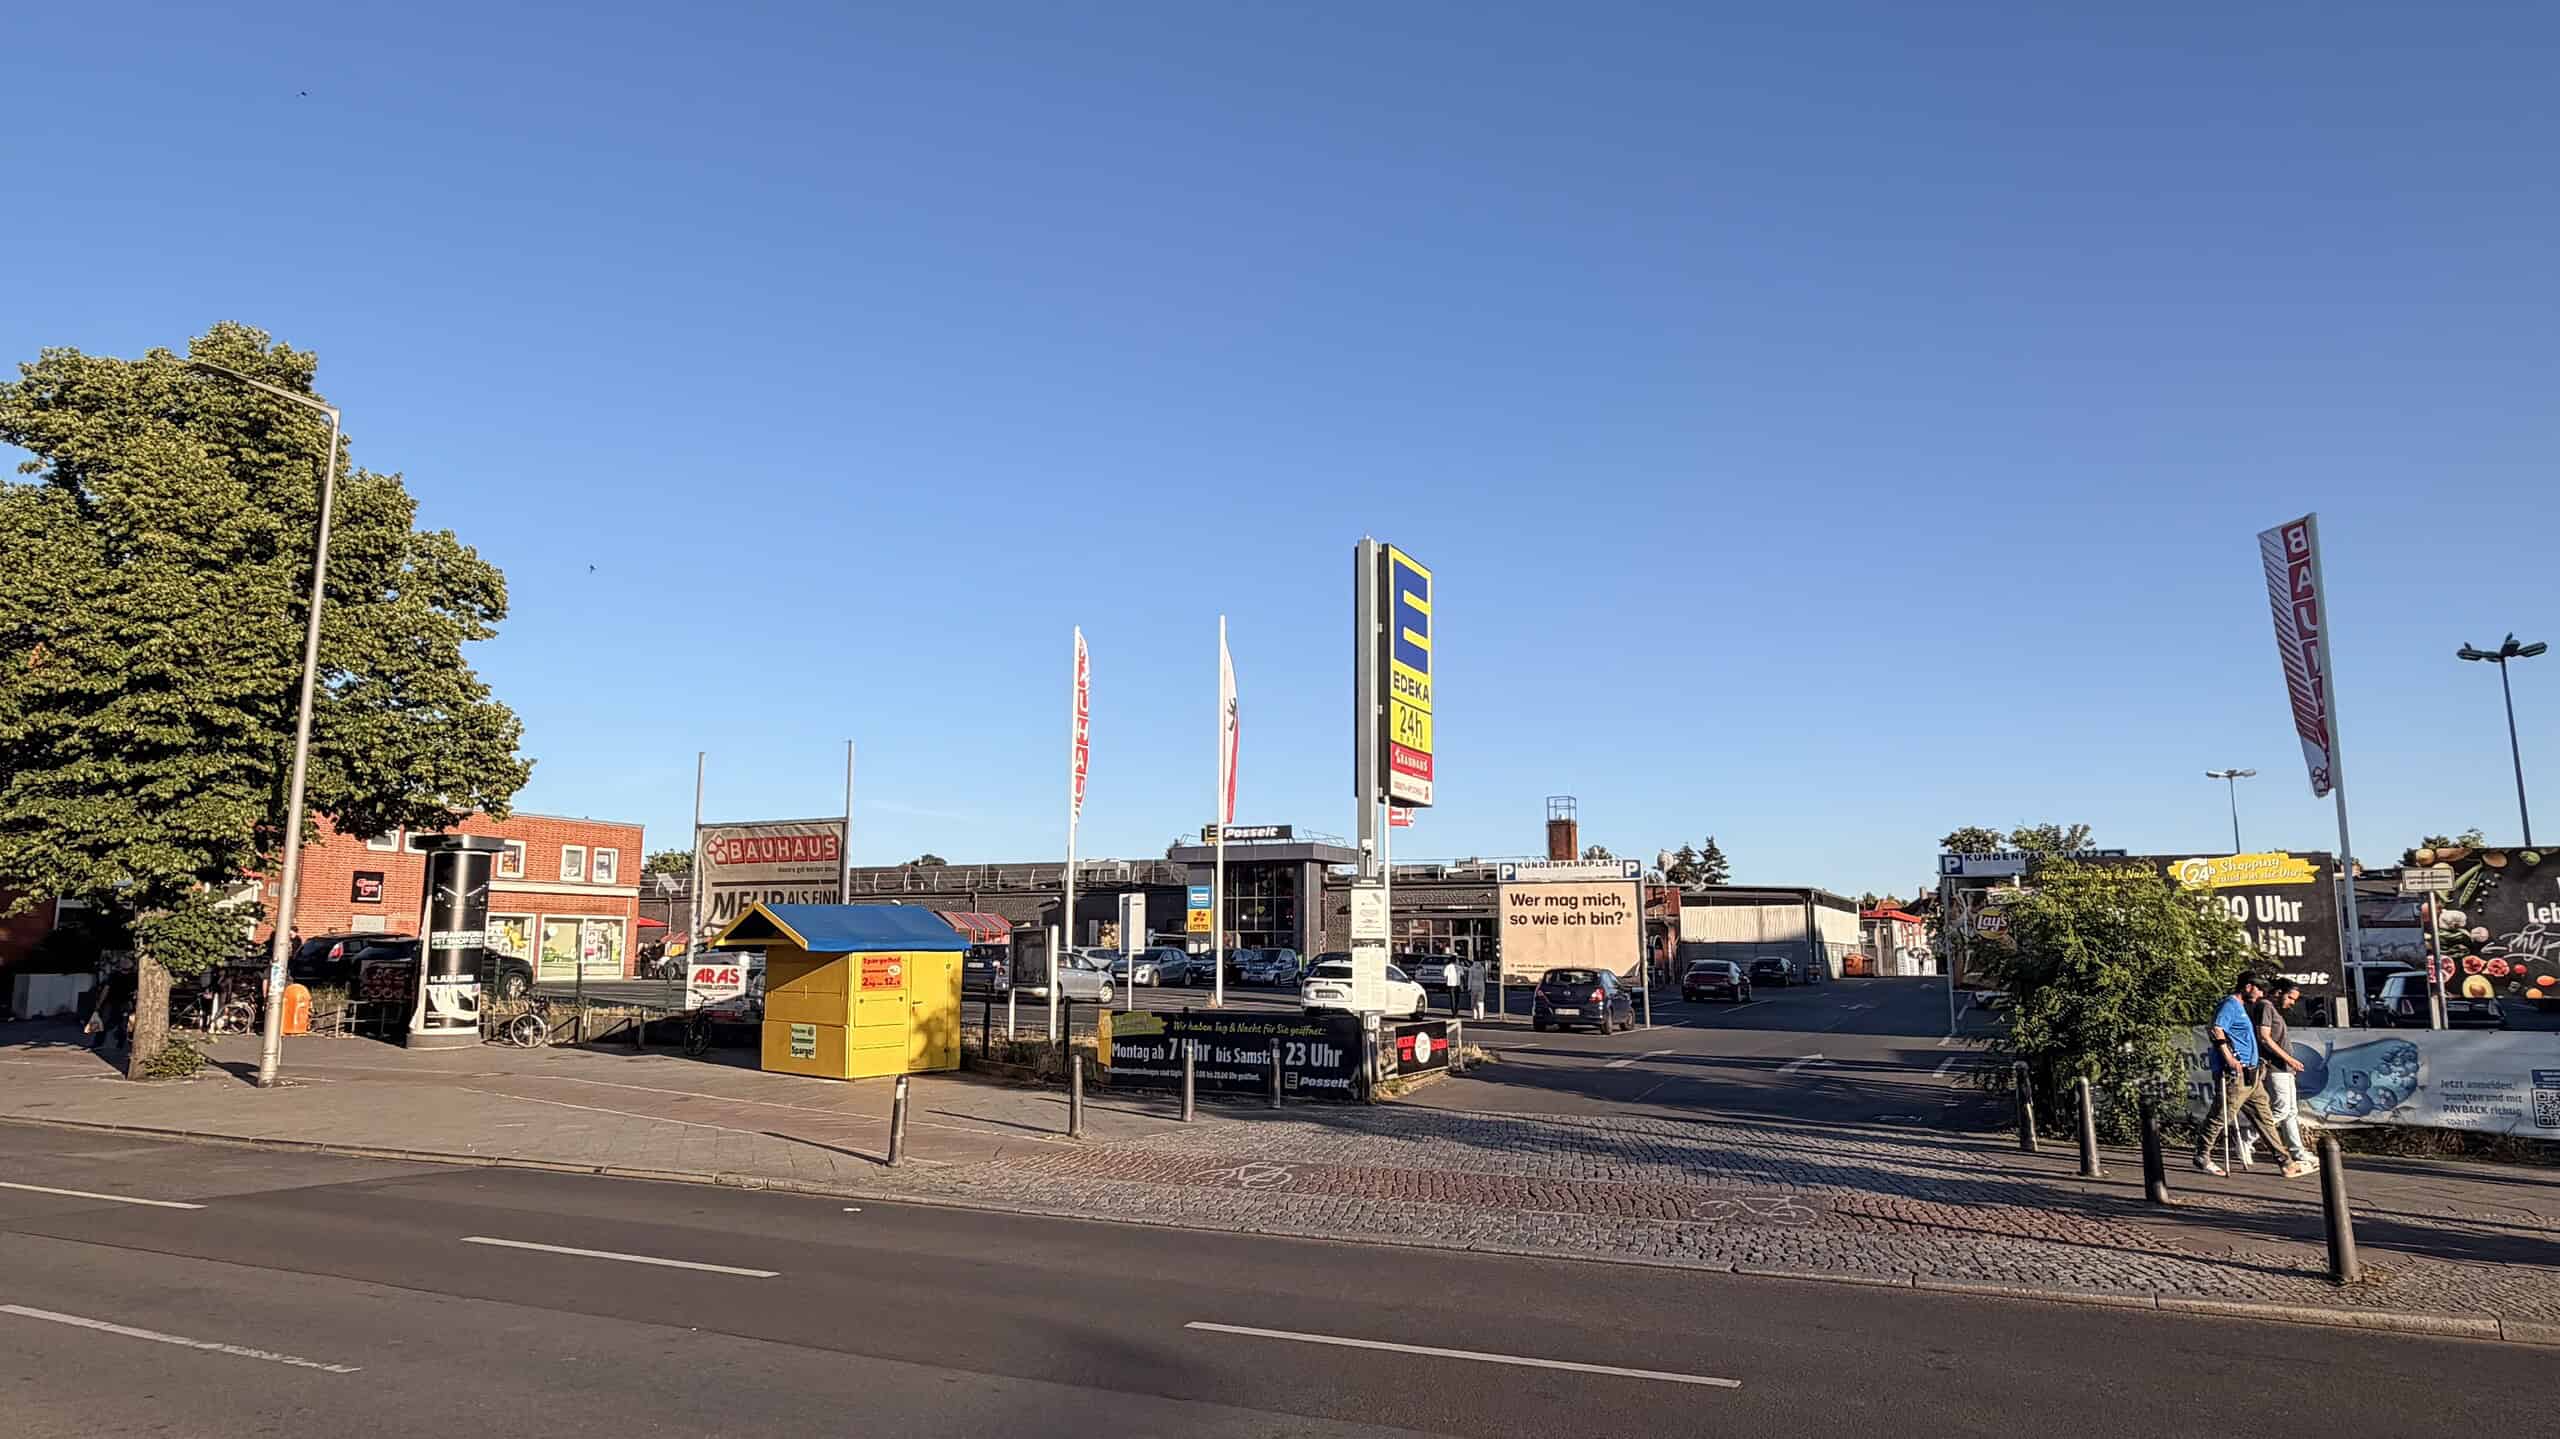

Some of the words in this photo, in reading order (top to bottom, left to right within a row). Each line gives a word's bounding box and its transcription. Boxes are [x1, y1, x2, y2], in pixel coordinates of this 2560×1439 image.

[1393, 670, 1430, 703] EDEKA
[1400, 706, 1423, 739] 24h
[729, 836, 838, 860] BAUHAUS
[1965, 850, 2097, 862] KUNDENPARPLATZ
[1518, 859, 1621, 870] KUNDENPARKPLATZ
[2220, 858, 2281, 873] Shopping
[709, 891, 785, 919] MER
[1510, 893, 1540, 907] Wer
[1545, 895, 1577, 910] mag
[1583, 893, 1626, 909] mich,
[2256, 895, 2303, 922] Uhr
[1510, 914, 1527, 925] so
[1532, 912, 1558, 925] wie
[1563, 912, 1586, 925] ich
[1977, 913, 2008, 931] Lay's
[2257, 928, 2306, 957] Uhr
[693, 967, 740, 984] ARAS
[2276, 971, 2330, 985] selt
[1187, 1021, 1212, 1031] haben
[1215, 1022, 1228, 1034] Tag
[1237, 1022, 1261, 1033] Nacht
[1277, 1024, 1289, 1034] Sie
[1112, 1042, 1149, 1062] Montag
[1152, 1044, 1164, 1060] ab
[1169, 1038, 1178, 1060] 7
[1215, 1046, 1231, 1063] bis
[1233, 1047, 1271, 1064] Samst
[1285, 1042, 1306, 1066] 23
[1310, 1043, 1343, 1068] Uhr
[2441, 1080, 2464, 1089] Jetzt
[2443, 1104, 2489, 1115] PAYBACK
